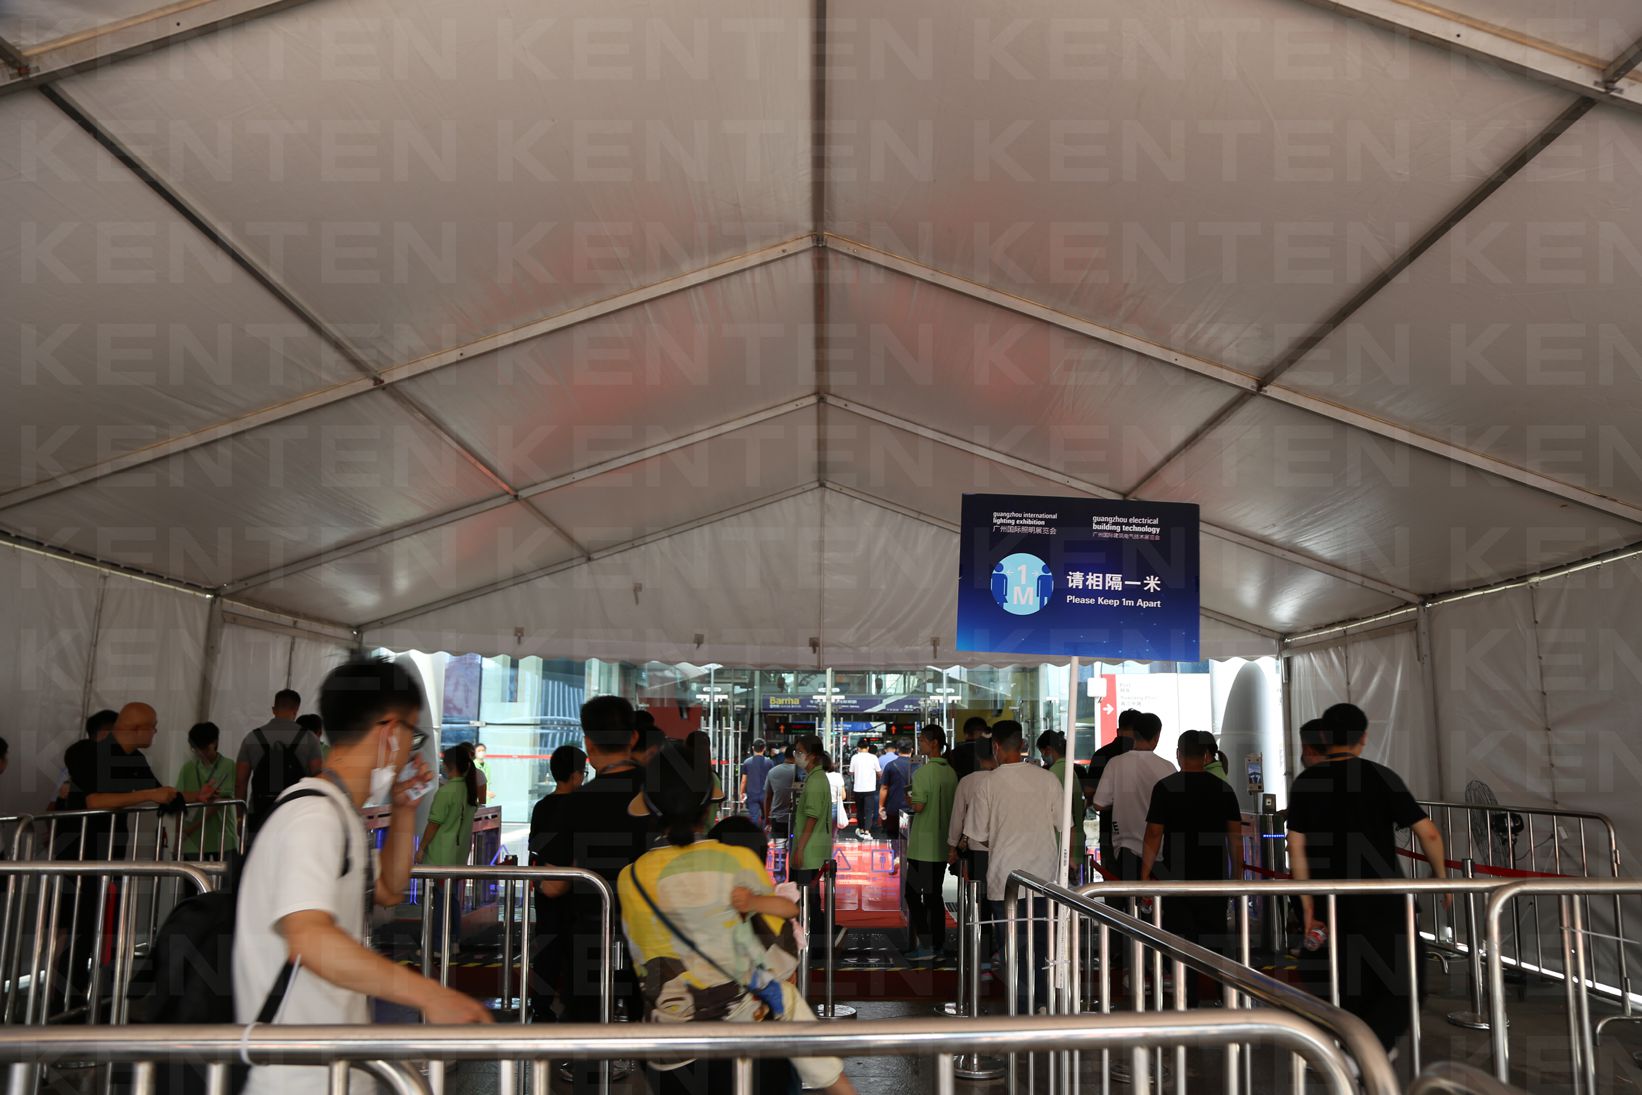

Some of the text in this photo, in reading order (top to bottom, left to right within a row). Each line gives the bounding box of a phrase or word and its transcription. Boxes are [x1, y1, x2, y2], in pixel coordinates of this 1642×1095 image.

[992, 511, 1023, 519] guangzhou
[1128, 517, 1159, 525] electrical
[992, 518, 1015, 526] lighting
[1092, 523, 1161, 534] building technology
[1017, 564, 1027, 585] 1
[1066, 571, 1162, 593] 请相隔一米
[1012, 586, 1034, 606] M
[1066, 595, 1162, 609] Please Keep 1m Apart
